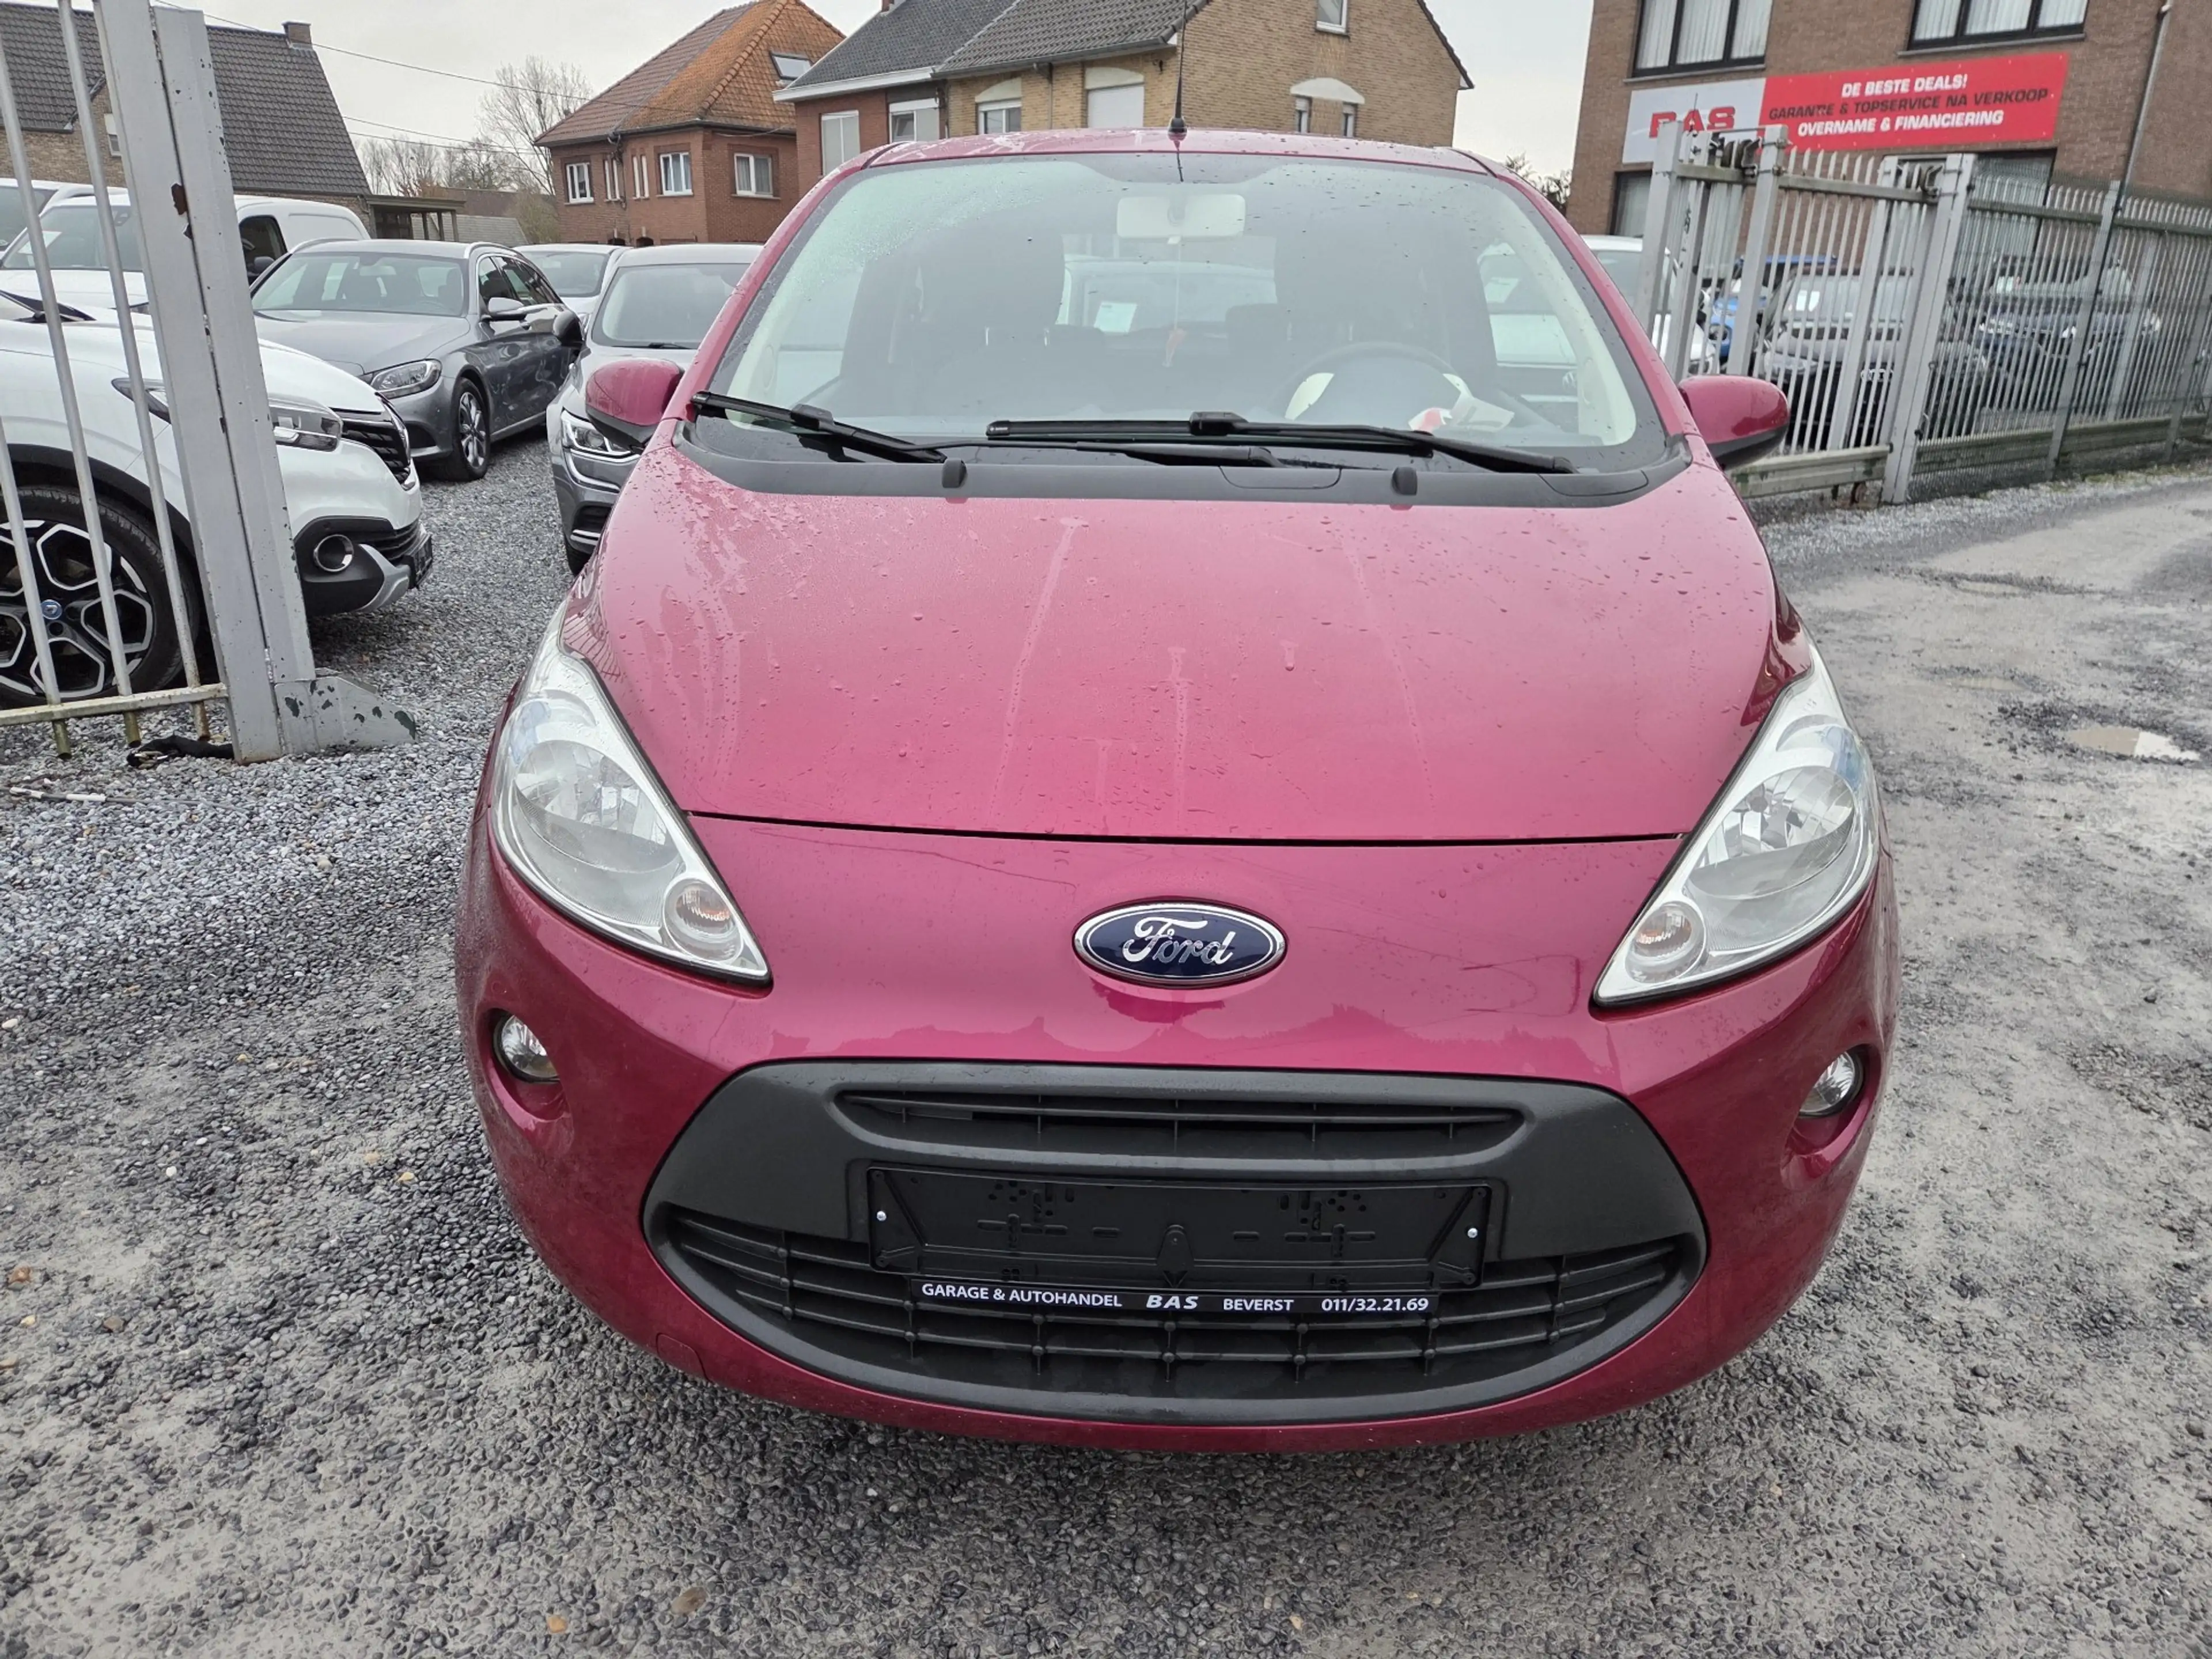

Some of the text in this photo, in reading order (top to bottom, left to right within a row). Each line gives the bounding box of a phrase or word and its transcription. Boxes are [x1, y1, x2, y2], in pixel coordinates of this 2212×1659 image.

[1842, 74, 1968, 98] DE BESTE DEALS!
[1839, 101, 1848, 114] &
[1854, 95, 1941, 113] TOPSERVICE
[1946, 94, 1967, 108] NA
[1974, 88, 2048, 106] VERKOOP
[1797, 109, 2005, 137] OVERNAME & FINANCIERING
[1122, 916, 1237, 965] Ford
[922, 1283, 1429, 1313] GARAGE & AUTOHANDEL BAS BEVERST 011/32.21.69
